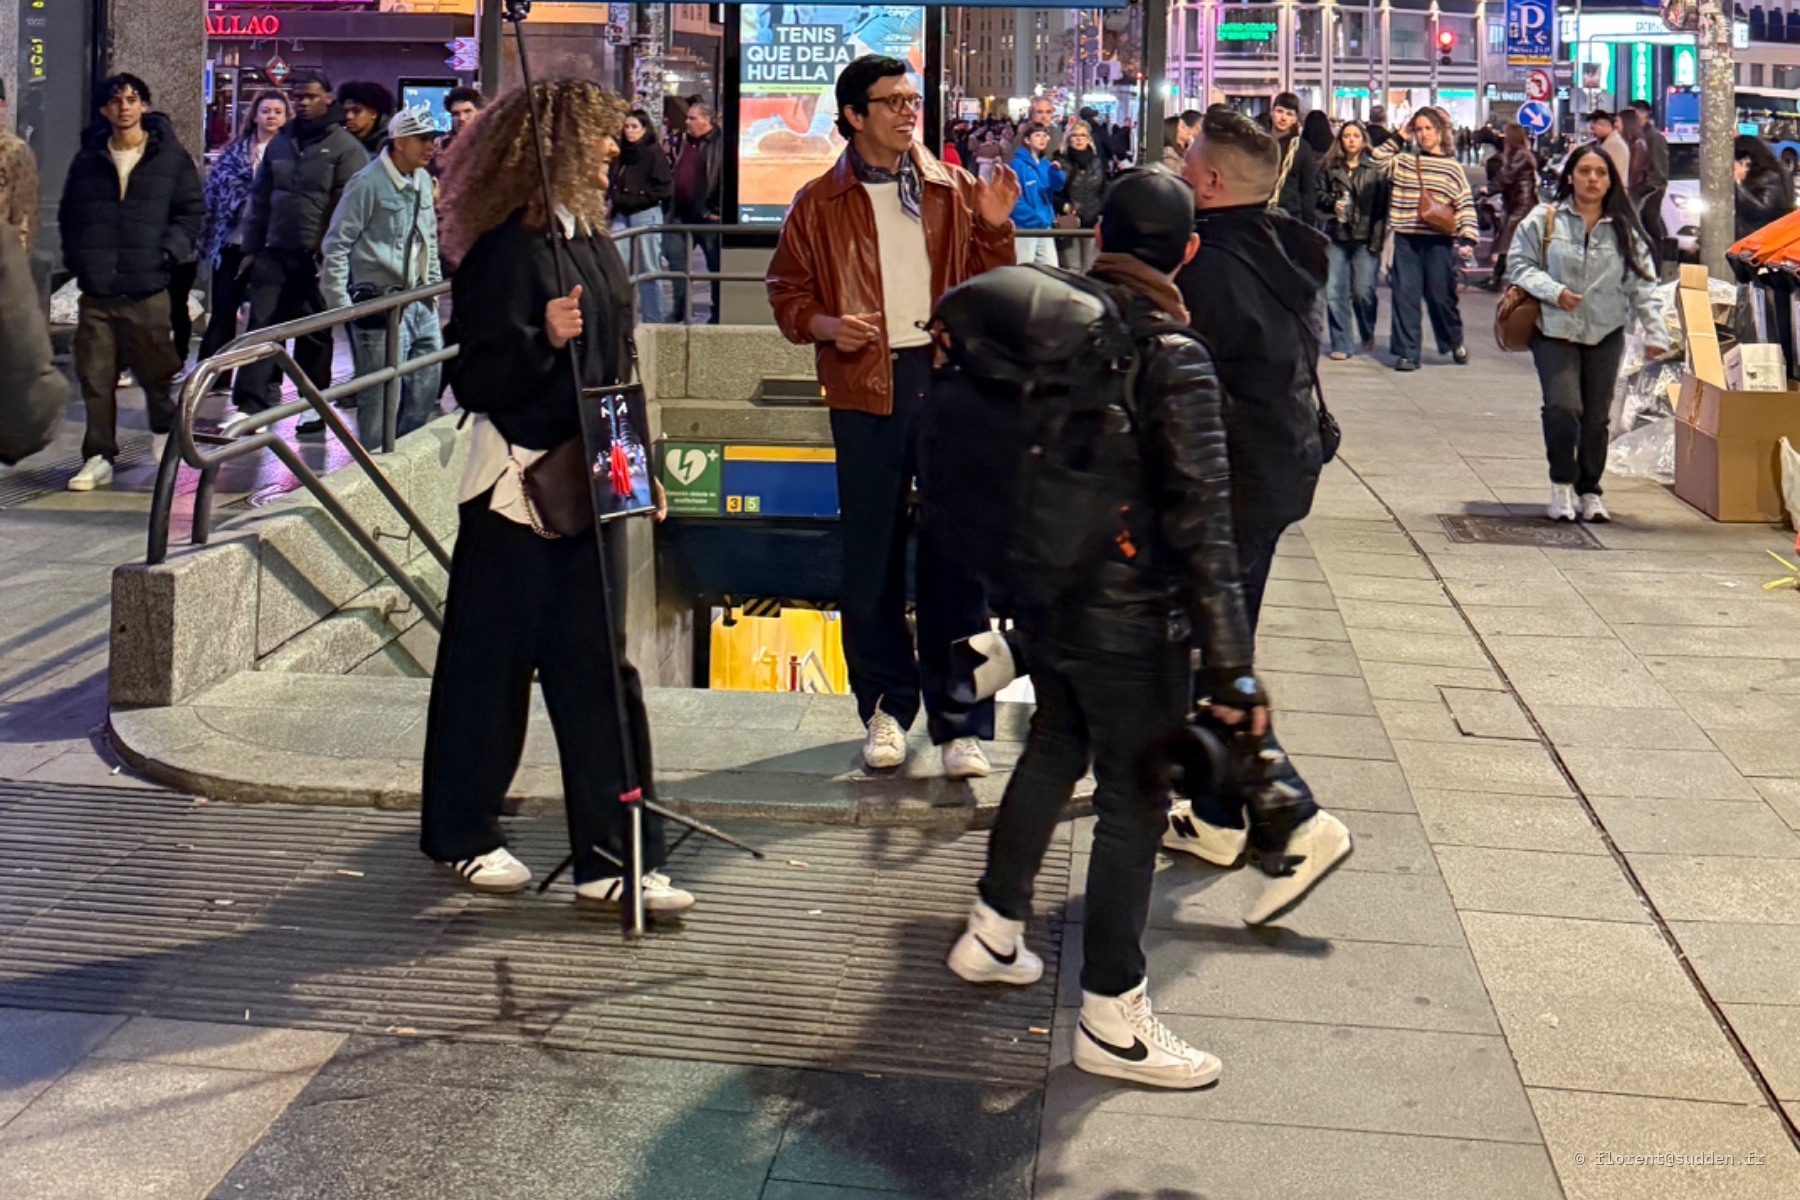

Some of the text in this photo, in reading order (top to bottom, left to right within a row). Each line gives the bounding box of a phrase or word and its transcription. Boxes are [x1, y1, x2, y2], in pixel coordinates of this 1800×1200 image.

[776, 27, 836, 43] TENIS
[747, 45, 850, 64] QUE DEJA
[748, 64, 829, 81] HUELLA
[730, 497, 757, 509] 3 5
